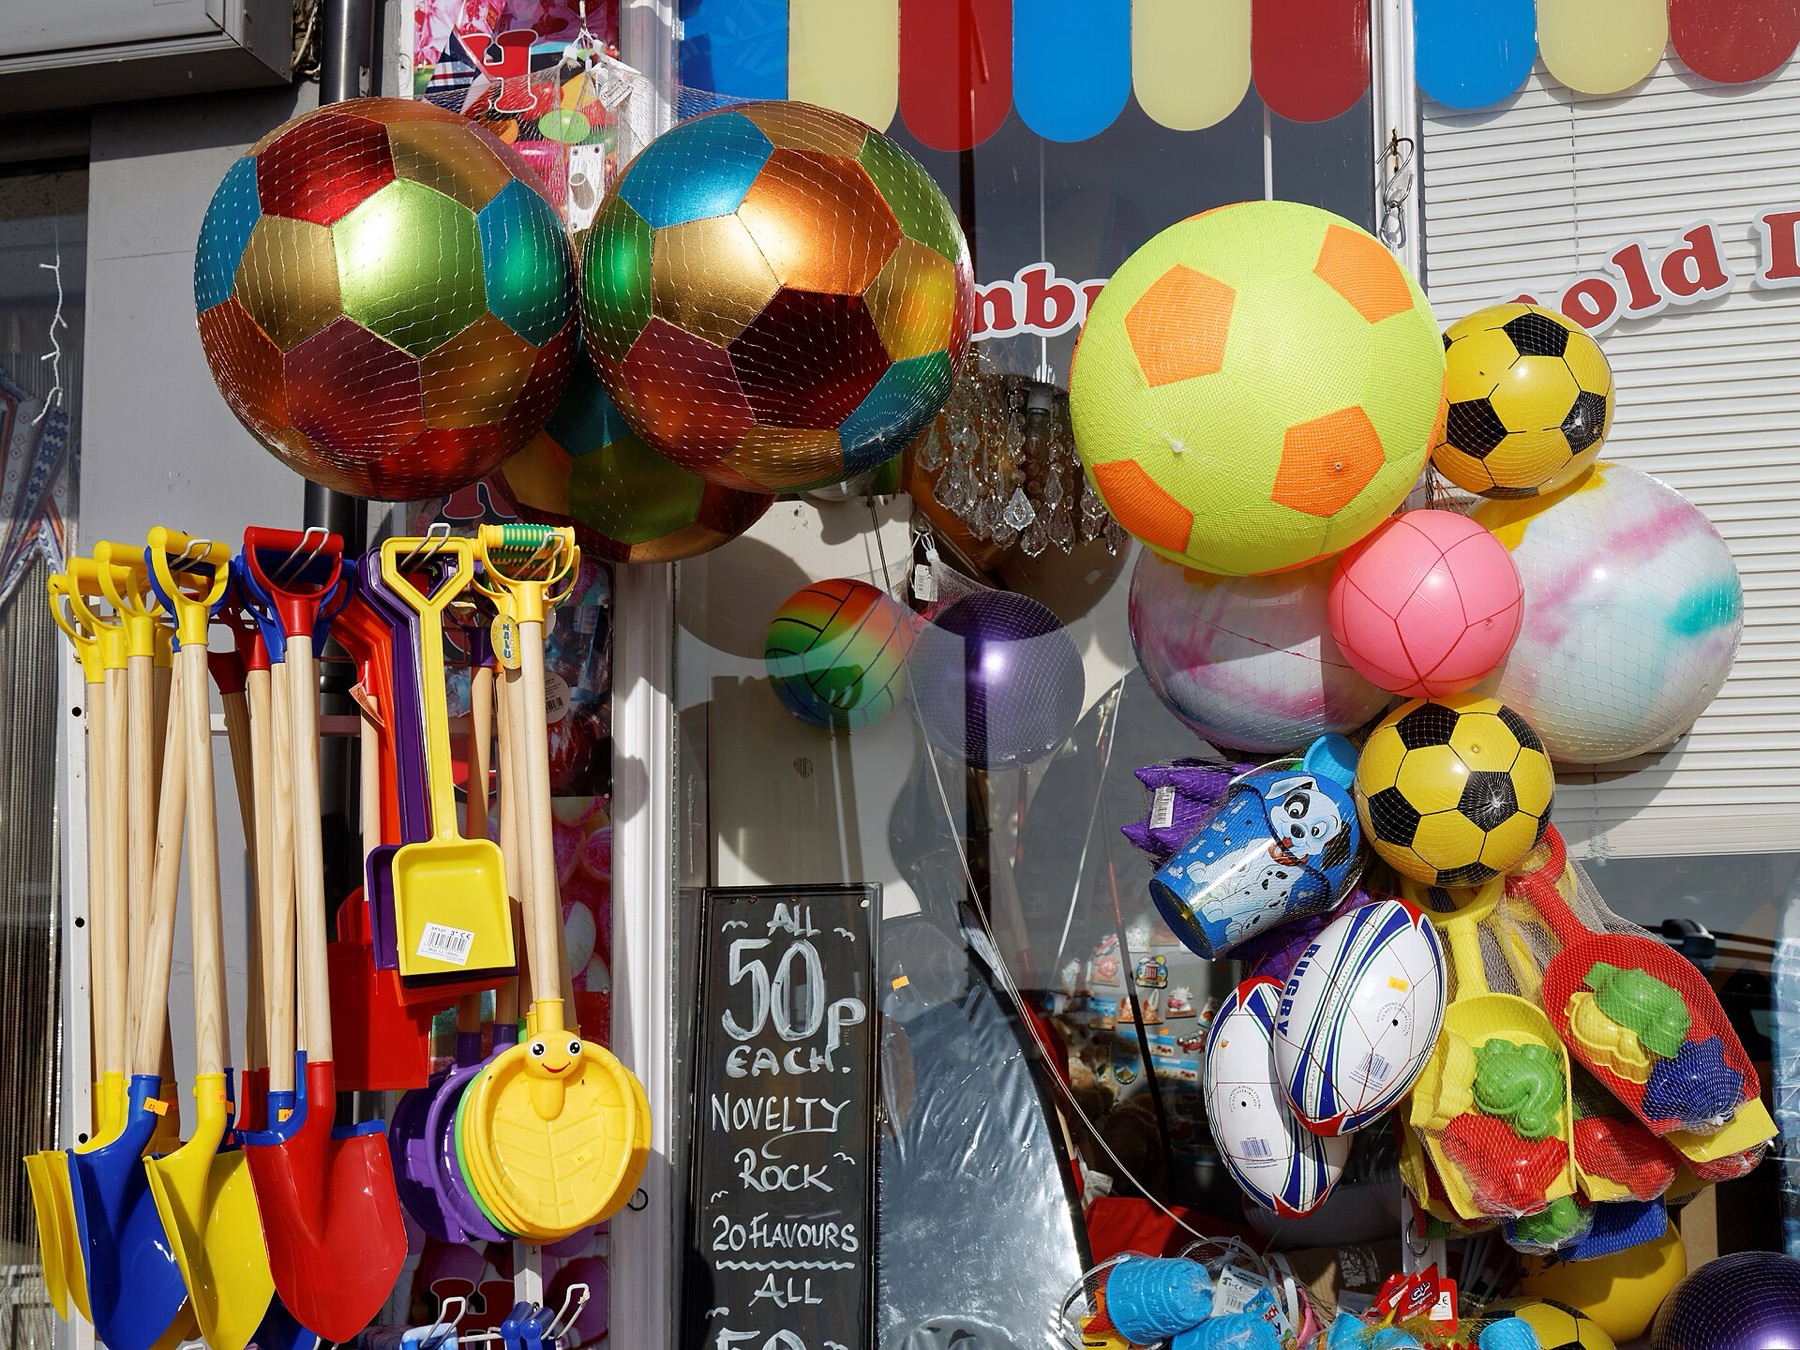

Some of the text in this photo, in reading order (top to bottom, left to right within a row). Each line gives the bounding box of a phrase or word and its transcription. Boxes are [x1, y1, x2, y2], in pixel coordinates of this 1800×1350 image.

[1508, 223, 1730, 330] old
[767, 902, 821, 937] ALL
[1277, 943, 1321, 1038] RUGBY
[711, 1092, 850, 1134] NOVELTY
[734, 1147, 833, 1193] ROCK
[712, 1211, 859, 1253] 20 FLAVOURS
[748, 1272, 823, 1309] ALL
